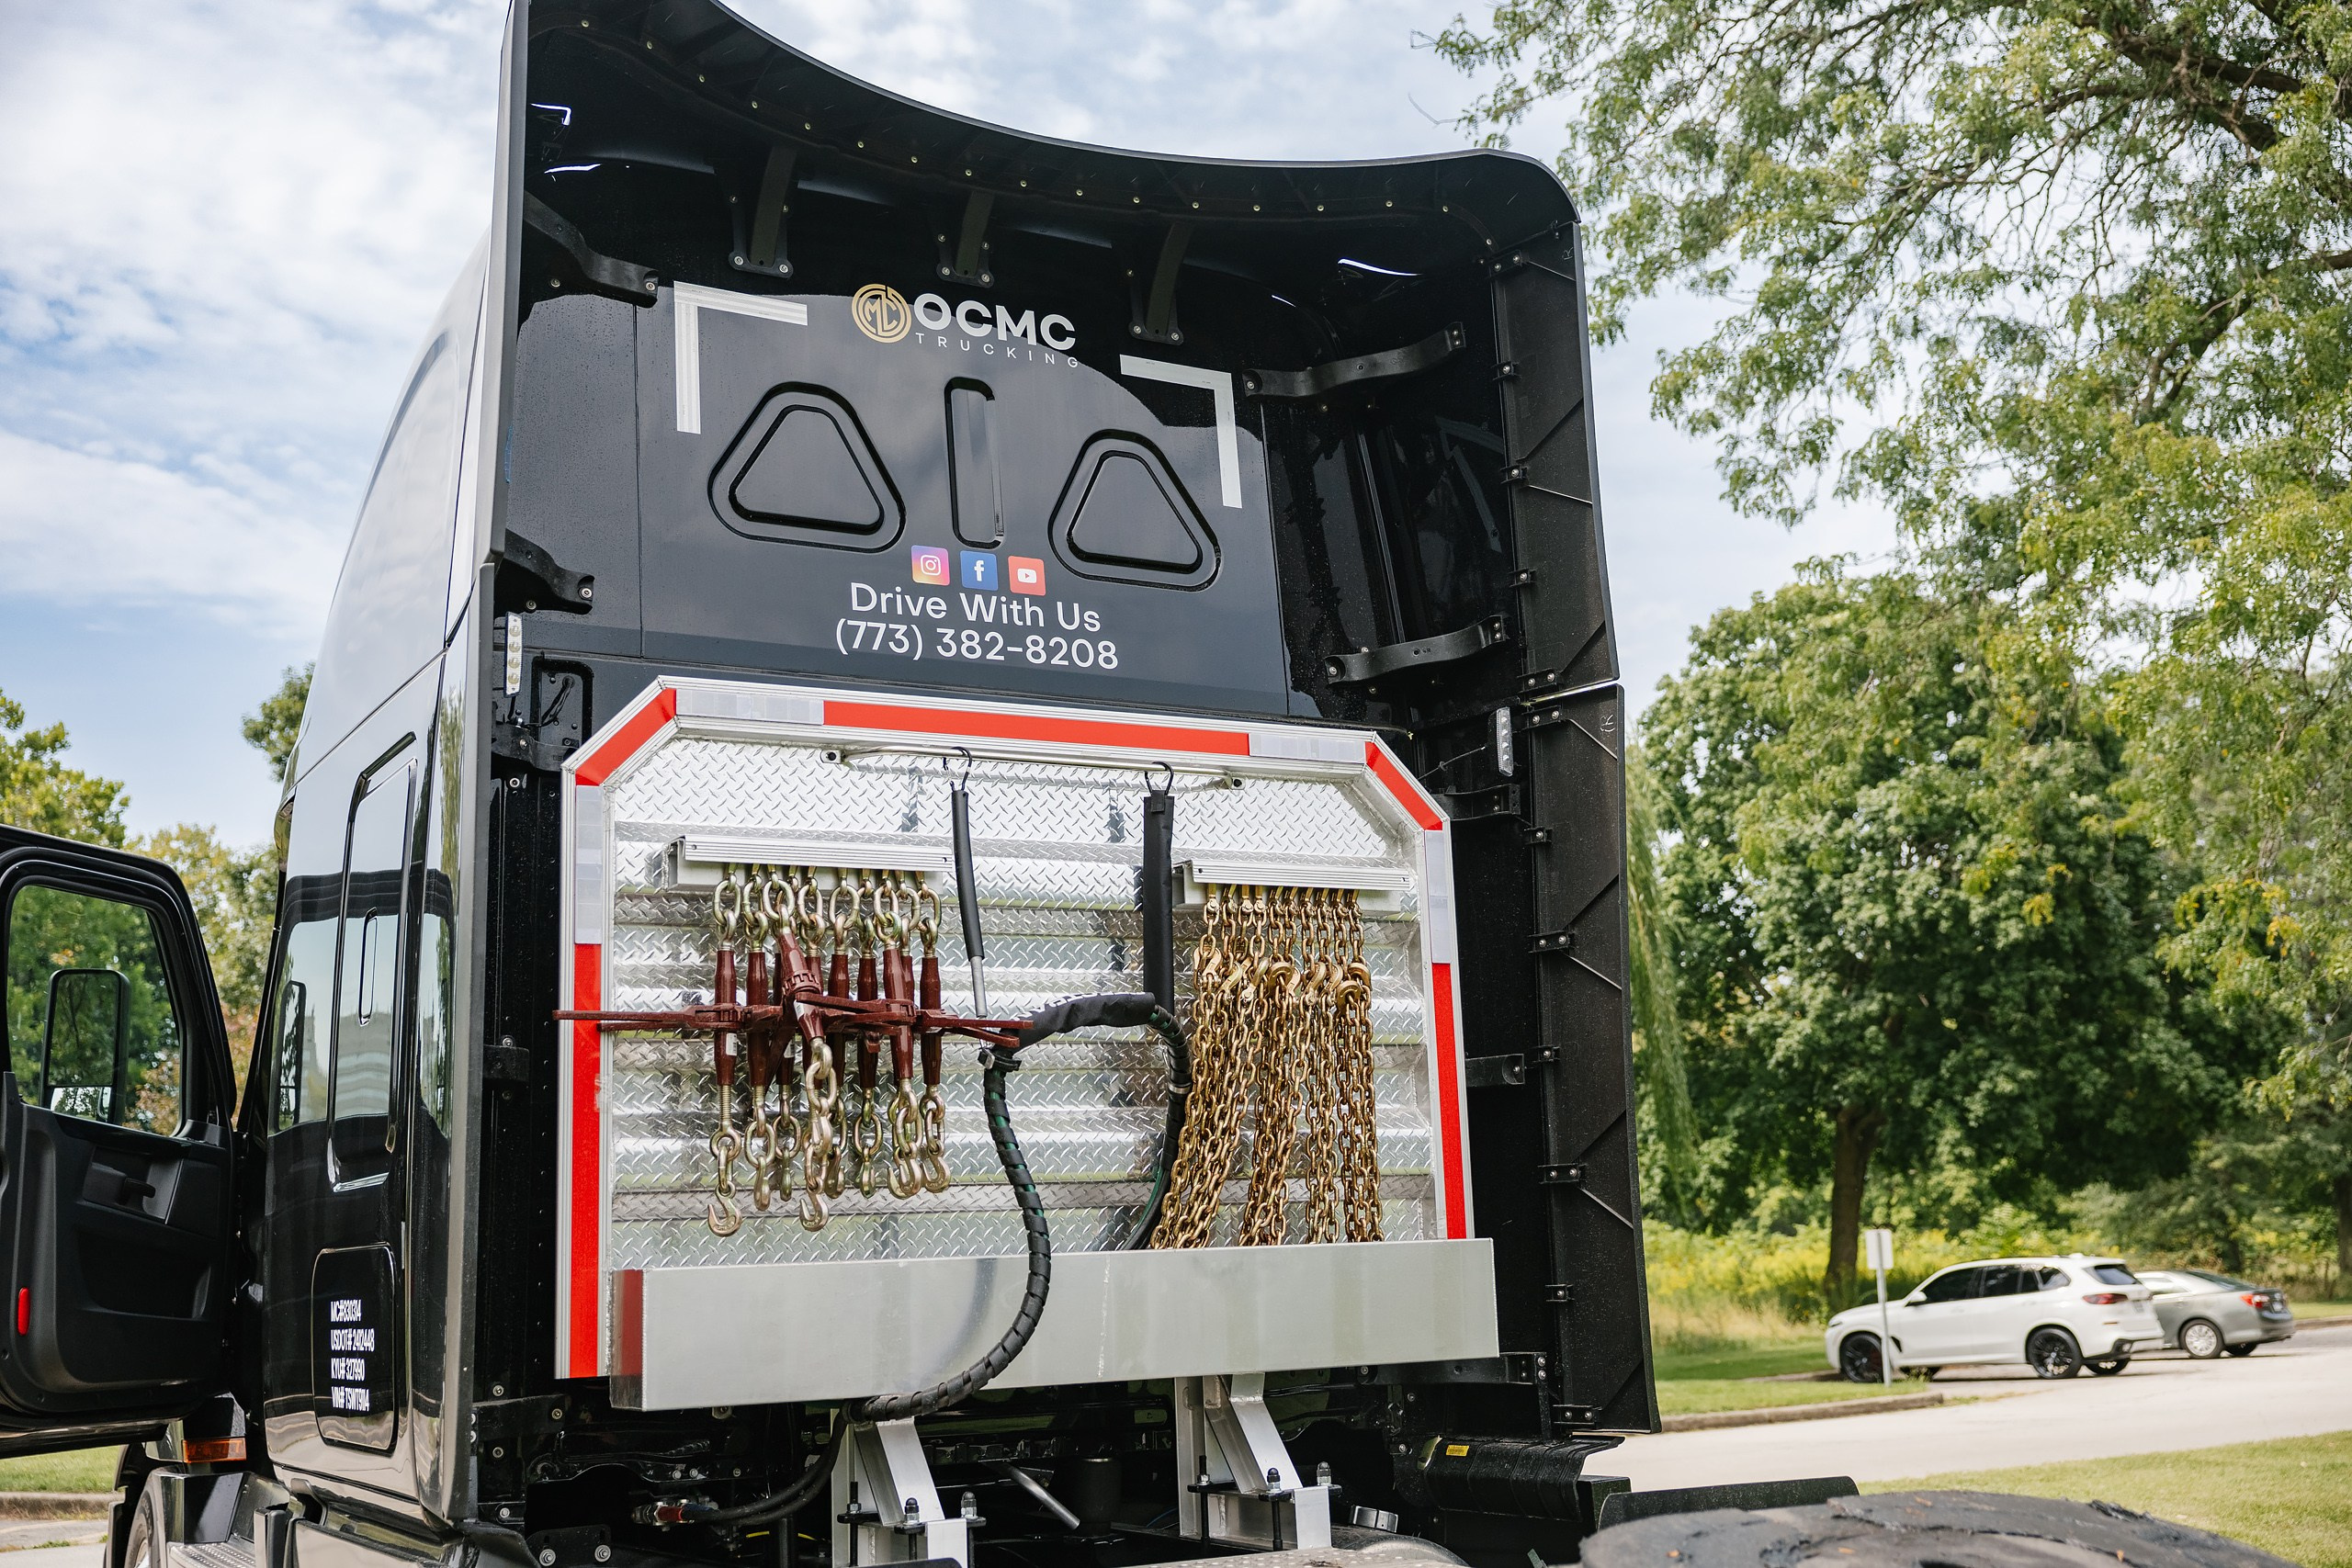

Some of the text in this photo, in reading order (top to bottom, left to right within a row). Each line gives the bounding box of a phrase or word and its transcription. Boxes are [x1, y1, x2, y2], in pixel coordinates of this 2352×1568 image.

[913, 292, 1076, 351] OCMC
[915, 332, 1079, 368] TRUCKING
[850, 581, 1101, 632] Drive With Us
[835, 618, 1119, 670] (773) 382-8208
